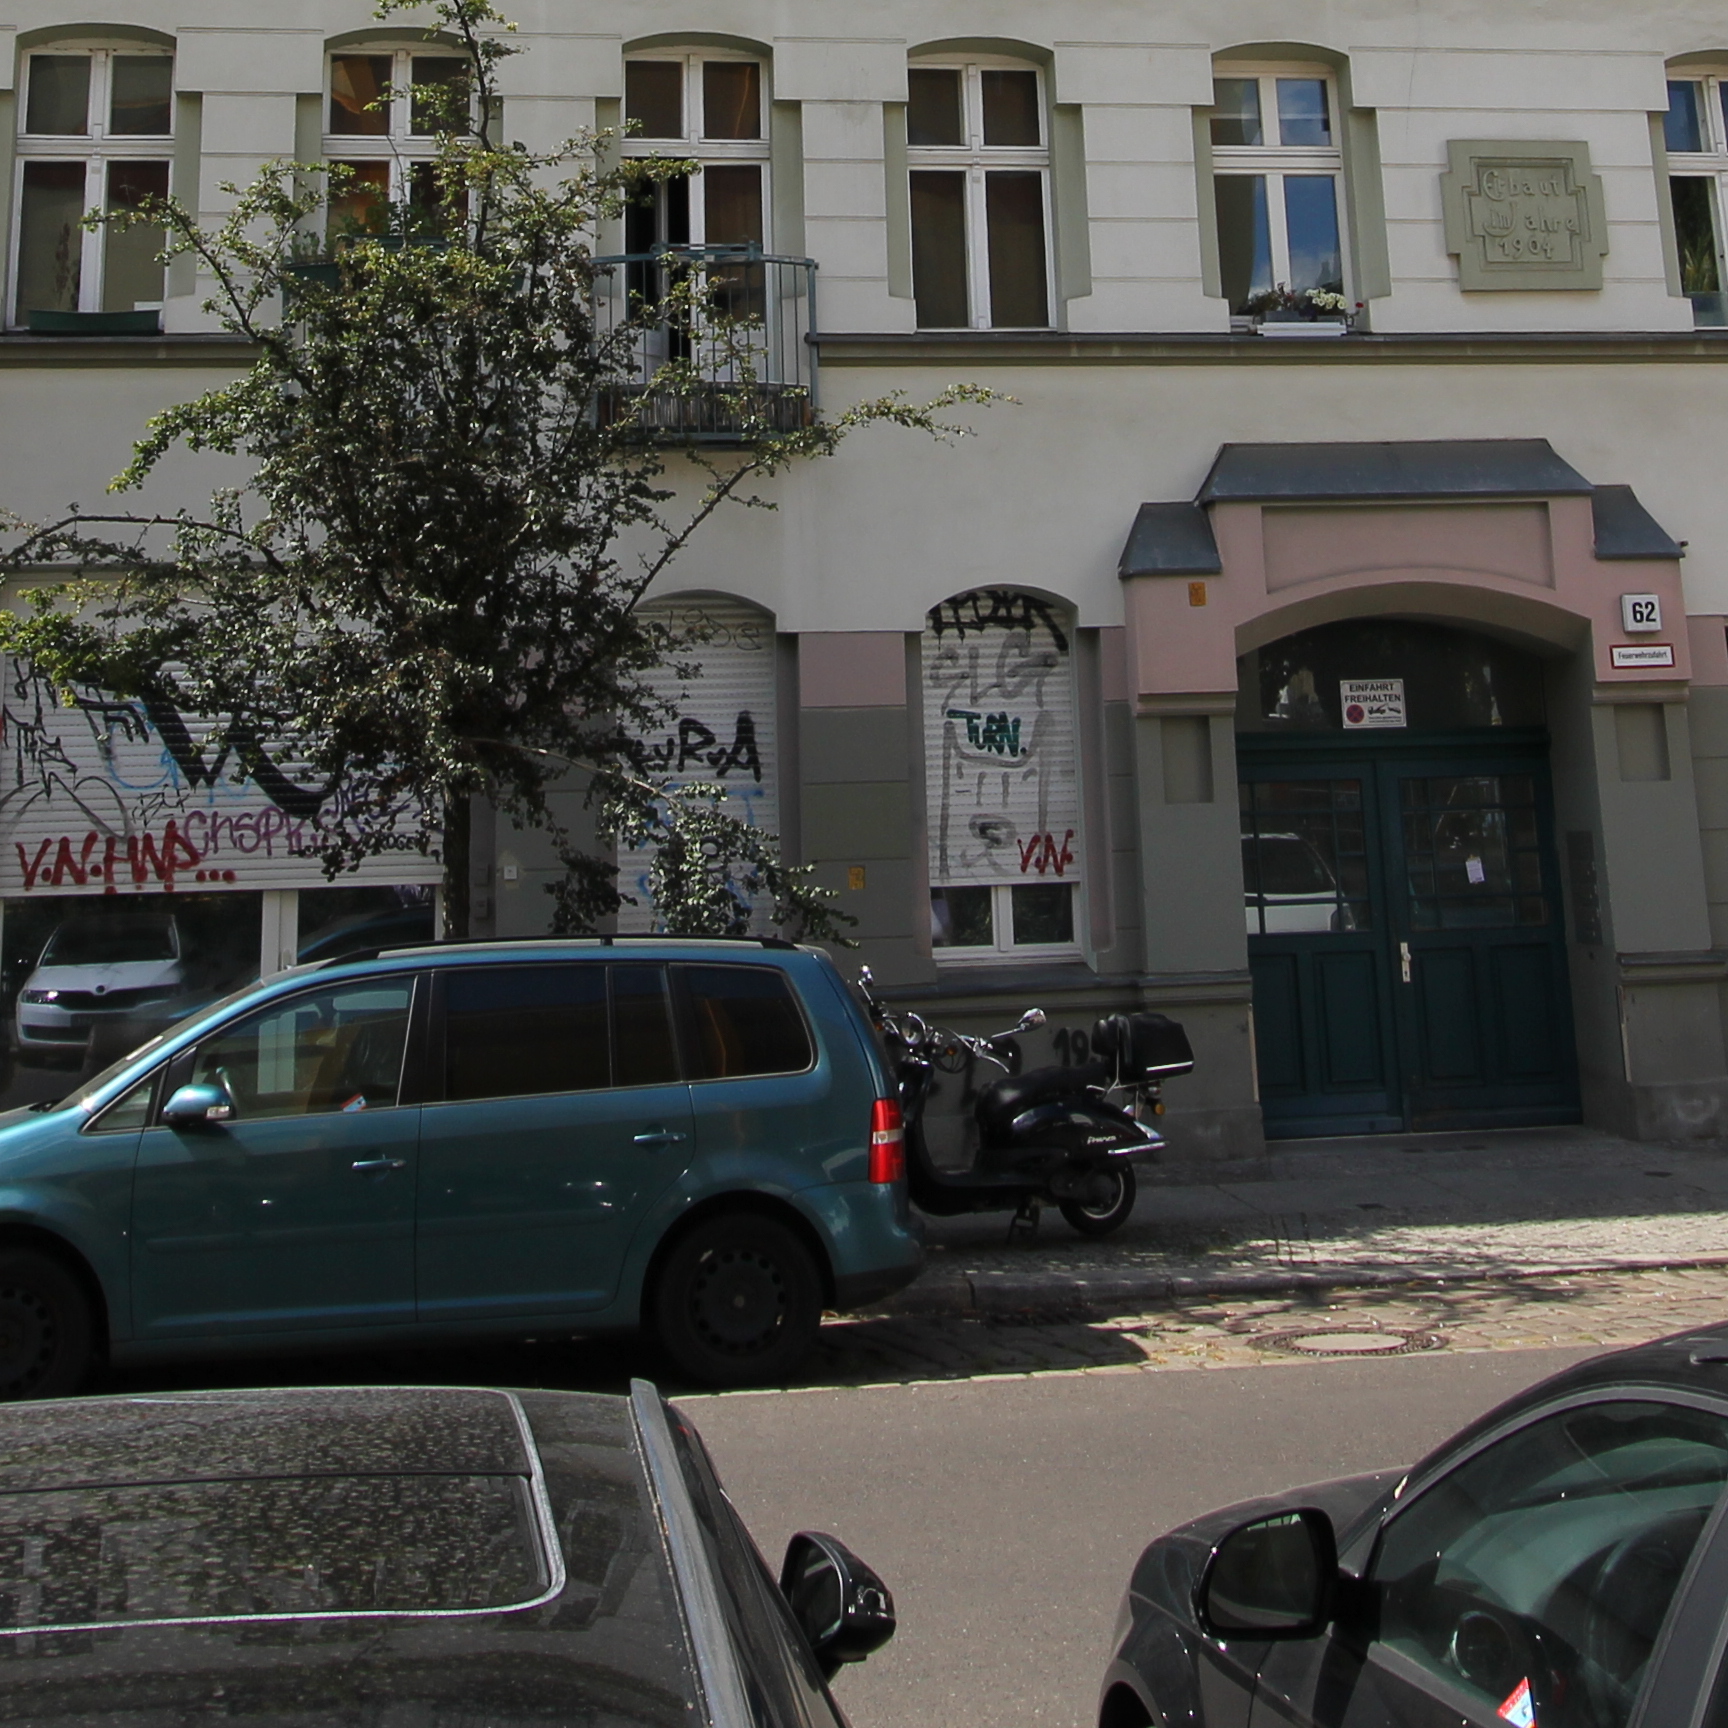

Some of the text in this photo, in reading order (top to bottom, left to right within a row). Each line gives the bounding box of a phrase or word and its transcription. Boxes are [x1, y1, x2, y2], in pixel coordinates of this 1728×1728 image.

[1632, 601, 1656, 623] 62
[1349, 683, 1394, 692] EINFAHRT
[1345, 693, 1401, 703] FREIHALTEN
